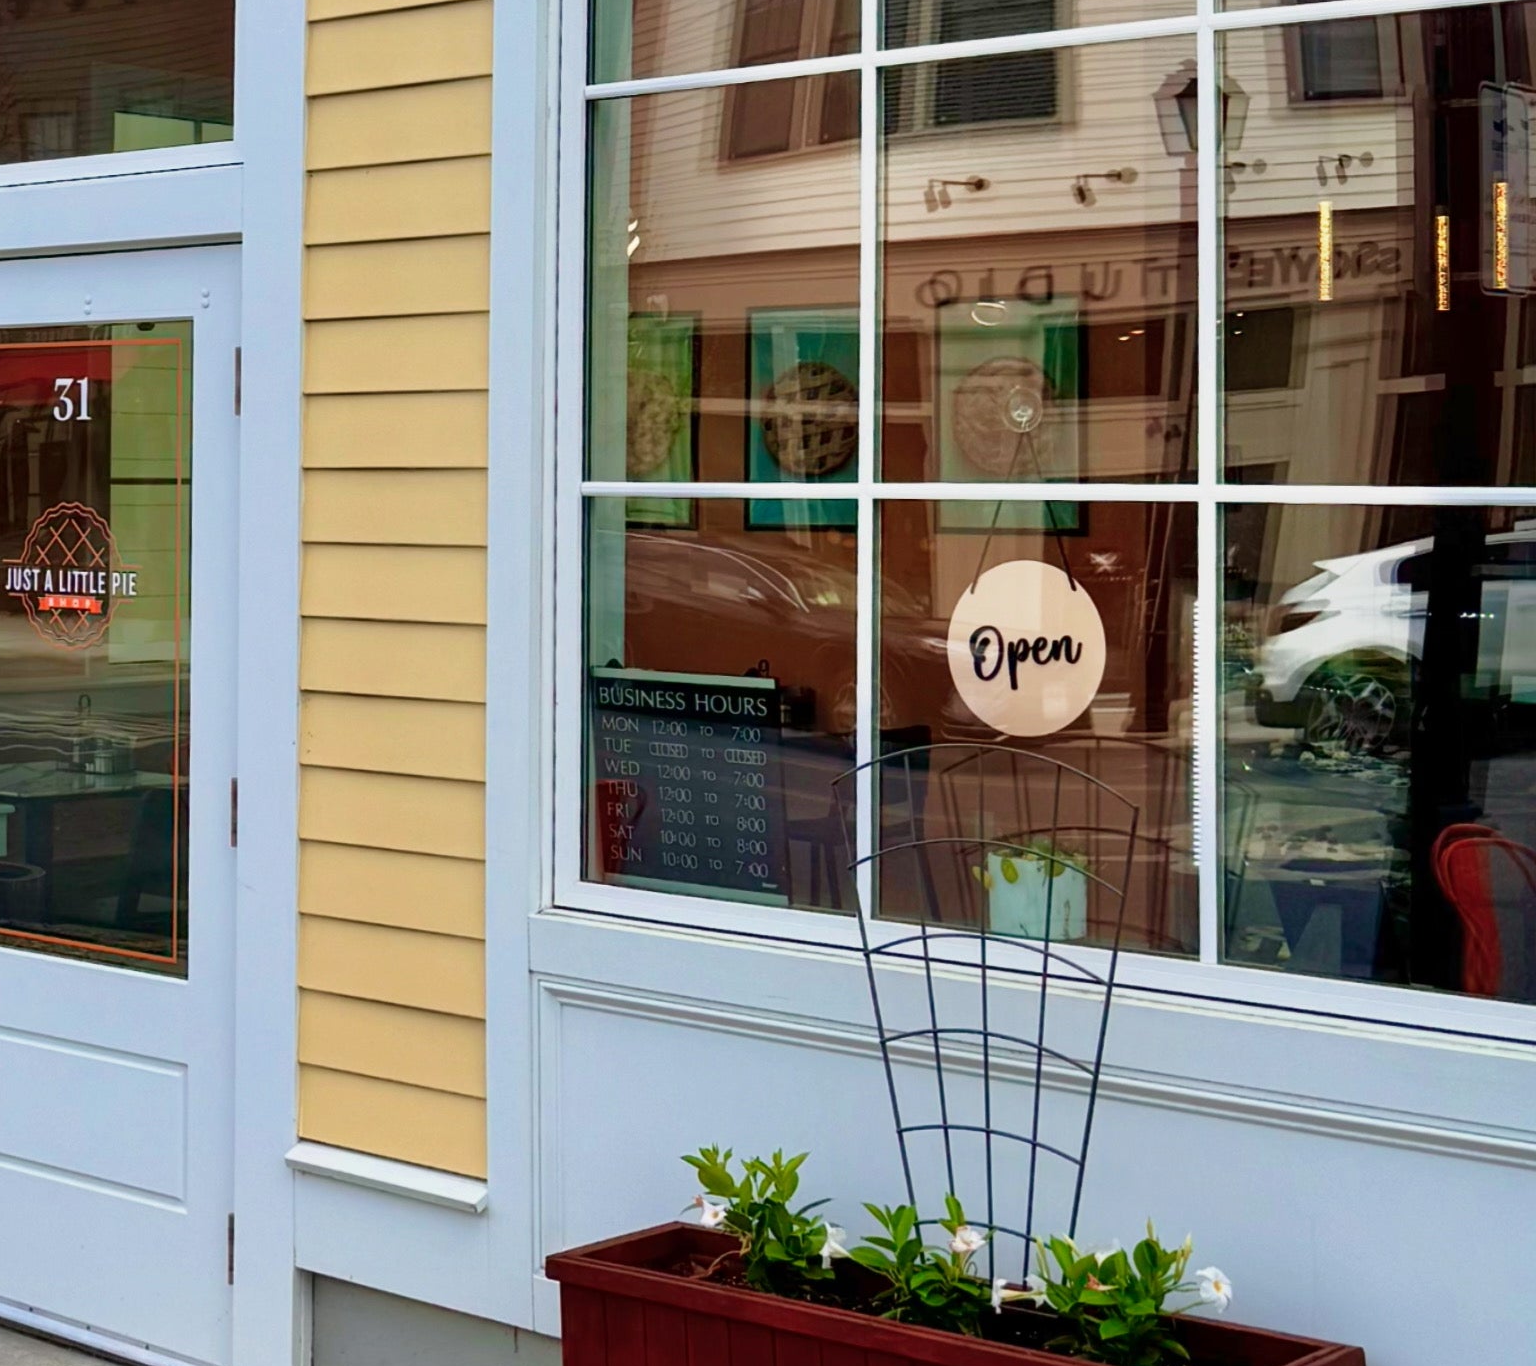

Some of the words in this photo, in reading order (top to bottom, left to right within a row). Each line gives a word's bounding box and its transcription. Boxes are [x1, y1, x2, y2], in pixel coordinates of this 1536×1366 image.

[53, 377, 92, 421] 31
[5, 567, 40, 591] JUST
[44, 569, 53, 592] A
[59, 570, 106, 594] LITTLE
[112, 572, 137, 596] PIE
[969, 625, 1082, 691] Open
[599, 687, 686, 711] BUSINESS
[695, 693, 768, 717] HOURS
[601, 716, 639, 733] MON
[652, 719, 688, 736] 12:00
[731, 726, 761, 743] 7:00
[604, 737, 632, 754] TUE
[649, 741, 689, 759] CLOSED
[724, 748, 767, 766] CLOSED
[605, 759, 640, 776] WED
[657, 765, 691, 781] 12:00
[734, 771, 764, 788] 7:00
[607, 781, 638, 798] THU
[659, 787, 692, 803] 12:00
[735, 794, 765, 811] 7:00
[607, 802, 630, 818] FRI
[661, 808, 694, 825] 12:00
[736, 817, 766, 834] 8:00
[609, 824, 635, 840] SAT
[660, 830, 696, 847] 10:00
[737, 839, 767, 856] 8:00
[611, 846, 642, 862] SUN
[662, 852, 698, 869] 10:00
